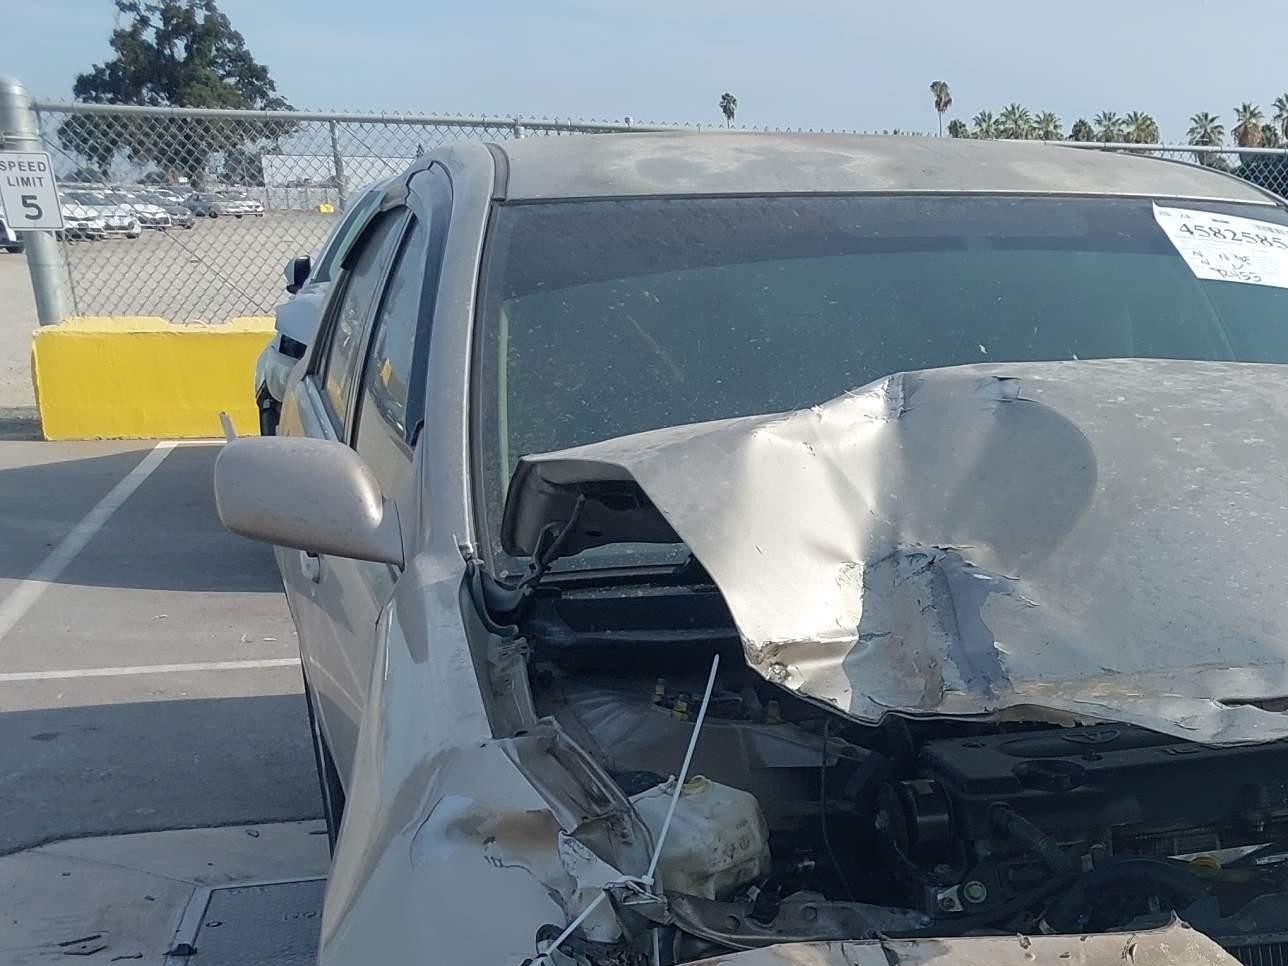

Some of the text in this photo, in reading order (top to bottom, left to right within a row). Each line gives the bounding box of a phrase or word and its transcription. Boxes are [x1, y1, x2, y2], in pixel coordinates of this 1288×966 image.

[0, 160, 47, 172] SPEED
[7, 176, 44, 187] LIMIT
[21, 194, 43, 220] 5
